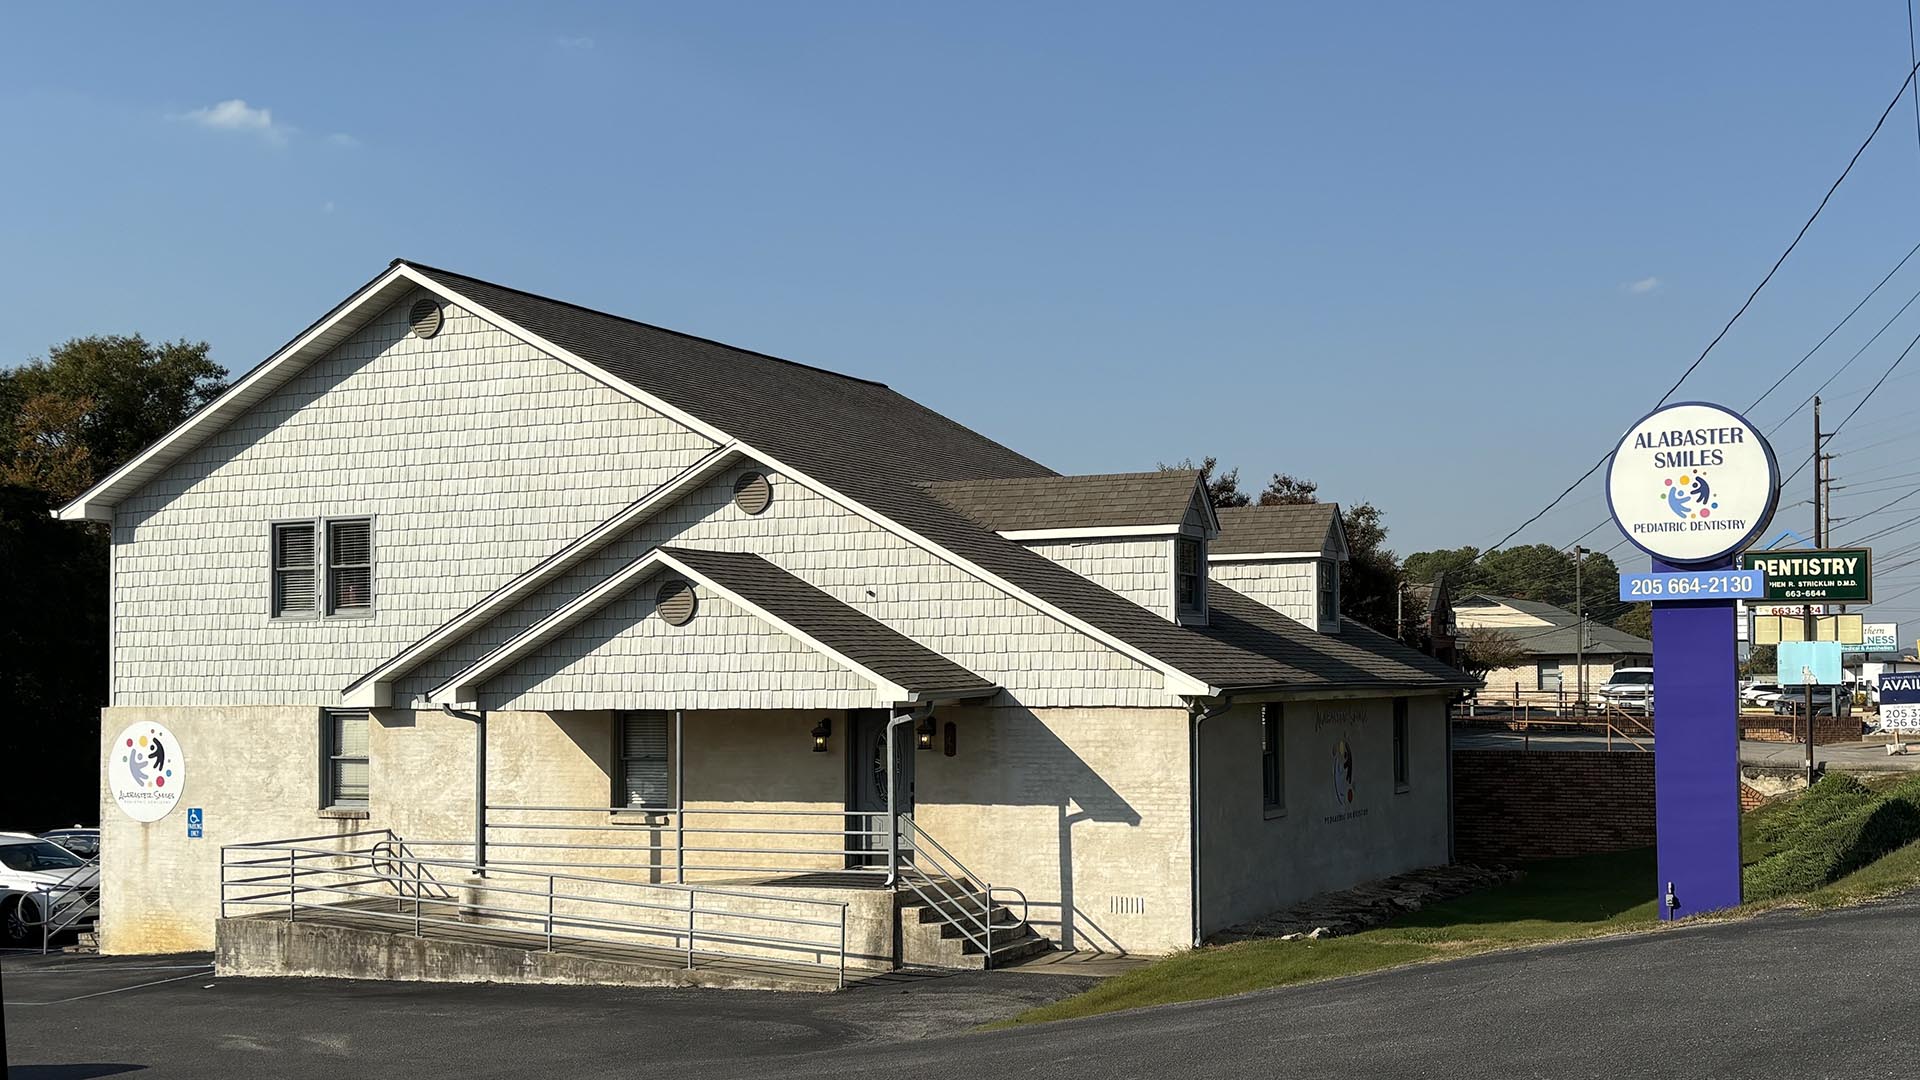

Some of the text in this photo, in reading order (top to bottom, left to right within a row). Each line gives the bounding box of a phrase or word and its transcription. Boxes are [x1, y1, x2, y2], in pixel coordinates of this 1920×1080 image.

[1634, 427, 1743, 449] ALABASTER
[1654, 449, 1723, 468] SMILES
[1634, 520, 1746, 533] PEDIATRIC DENTISTRY
[1754, 558, 1857, 576] DENTISTRY
[1631, 576, 1752, 595] 205 664-2130
